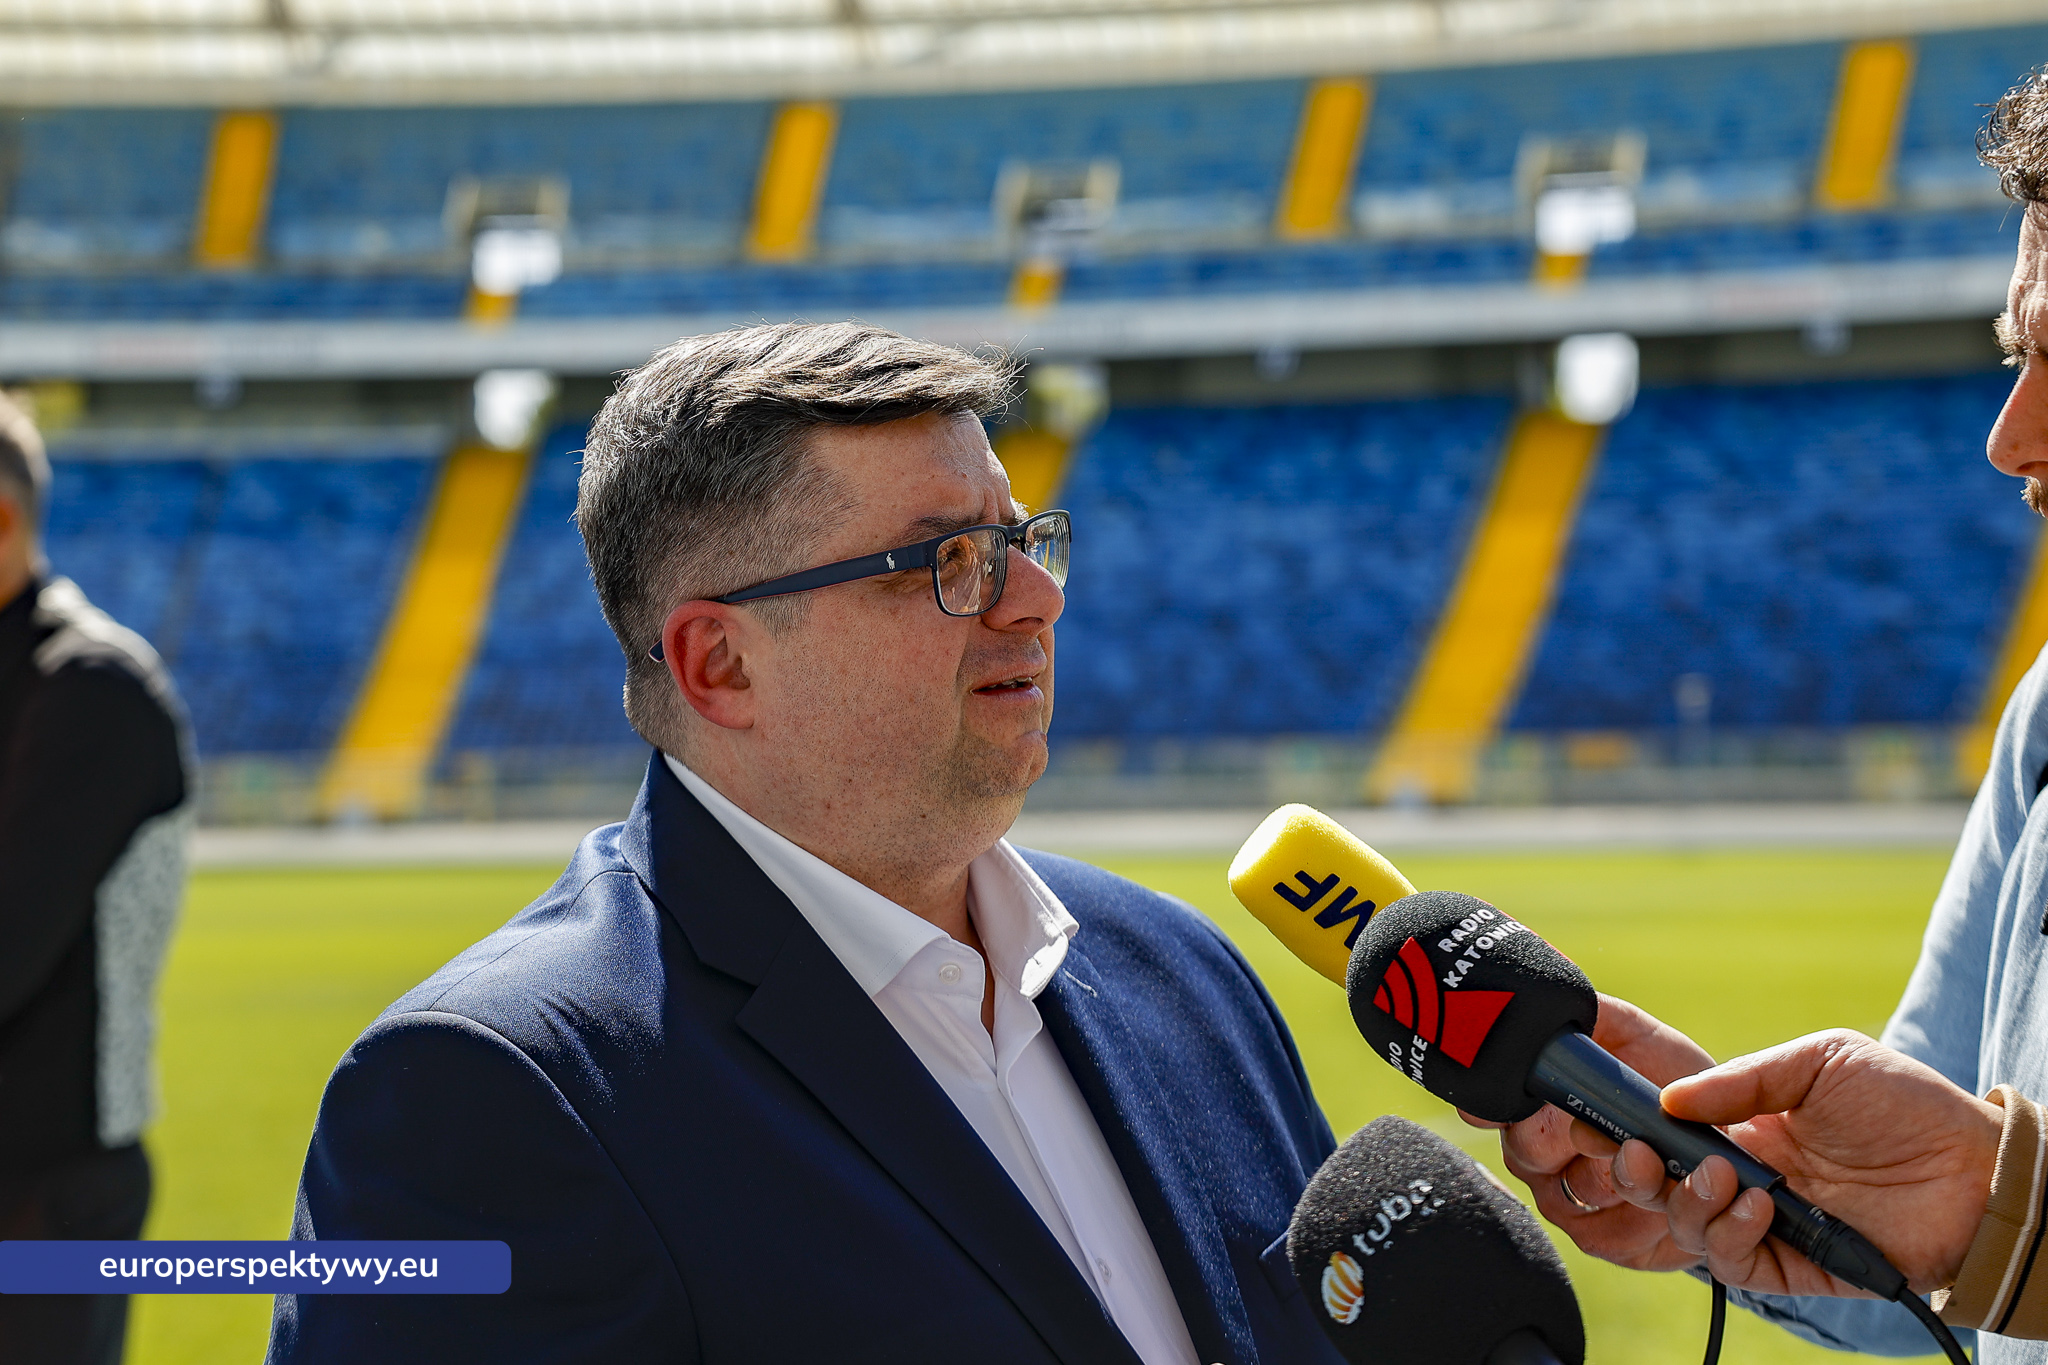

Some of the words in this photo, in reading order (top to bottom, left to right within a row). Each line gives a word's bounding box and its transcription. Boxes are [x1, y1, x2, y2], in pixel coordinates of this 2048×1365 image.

[1272, 869, 1377, 952] MF
[1437, 908, 1495, 953] RADIO
[1442, 920, 1532, 989] KATOWIC
[1388, 1041, 1405, 1075] DIO
[1409, 1034, 1428, 1088] WICE
[1583, 1106, 1634, 1140] SENNHE
